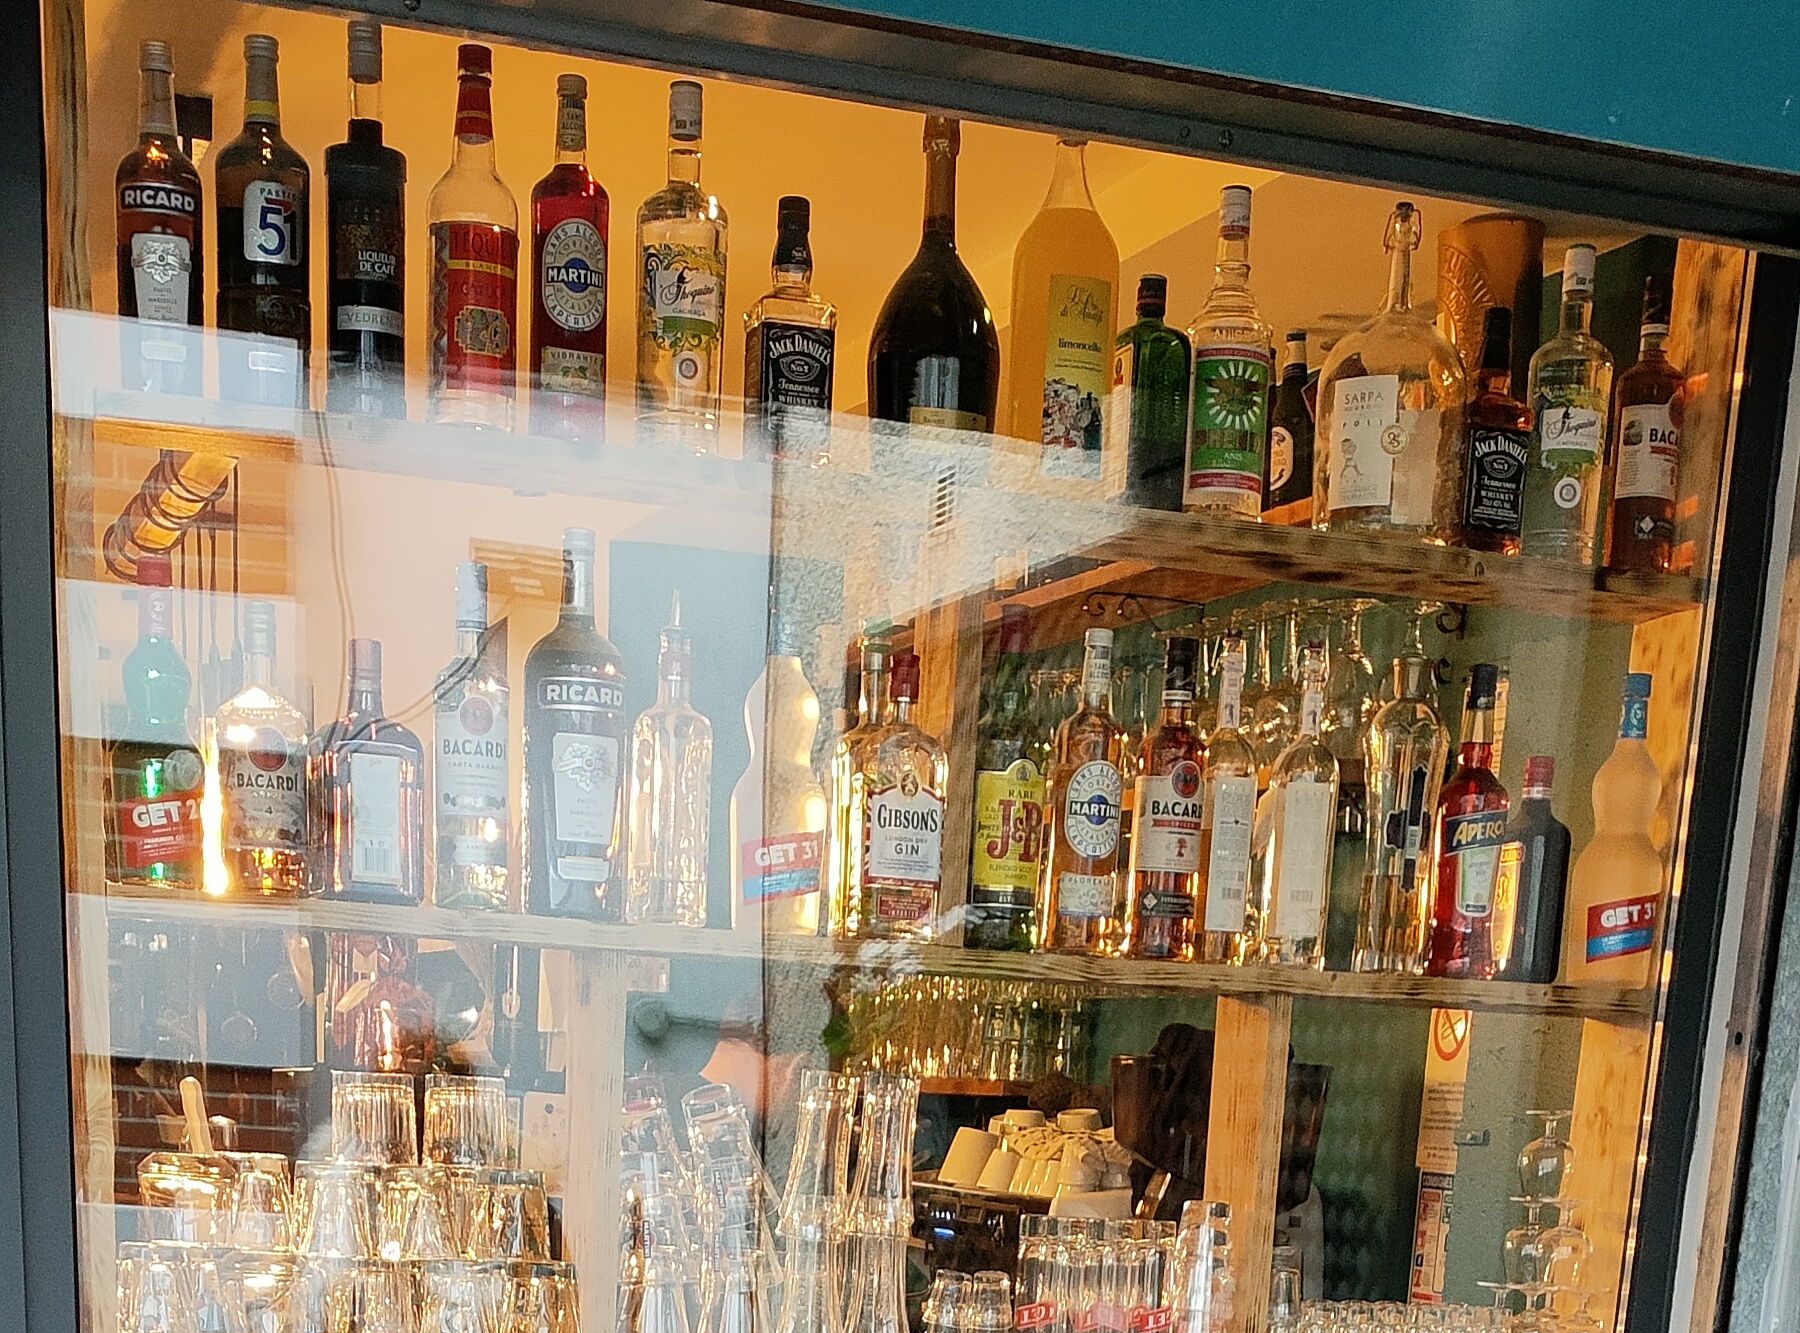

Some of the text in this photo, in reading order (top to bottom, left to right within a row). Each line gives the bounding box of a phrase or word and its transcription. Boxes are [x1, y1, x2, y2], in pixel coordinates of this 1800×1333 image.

[124, 189, 195, 212] RICARD
[257, 204, 298, 262] 51
[452, 231, 512, 257] TEQUIL
[547, 225, 568, 257] SANS
[359, 262, 373, 273] DE
[547, 267, 603, 288] MARTINI
[769, 333, 832, 366] JACK DANIEL'S
[778, 394, 819, 408] WHISKEY
[1344, 390, 1385, 405] SARPA
[1475, 438, 1497, 458] JACK
[546, 684, 624, 707] RICARD
[236, 772, 300, 793] BACARDÍ
[132, 798, 202, 829] GET 2
[877, 803, 938, 833] GIBSON'S
[1070, 801, 1120, 820] MARTINI
[1151, 799, 1202, 819] BACARD
[985, 798, 1044, 863] J&B
[1452, 819, 1505, 847] APERO
[754, 839, 819, 867] GET 31
[894, 843, 921, 857] GIN
[1600, 904, 1642, 928] GET
